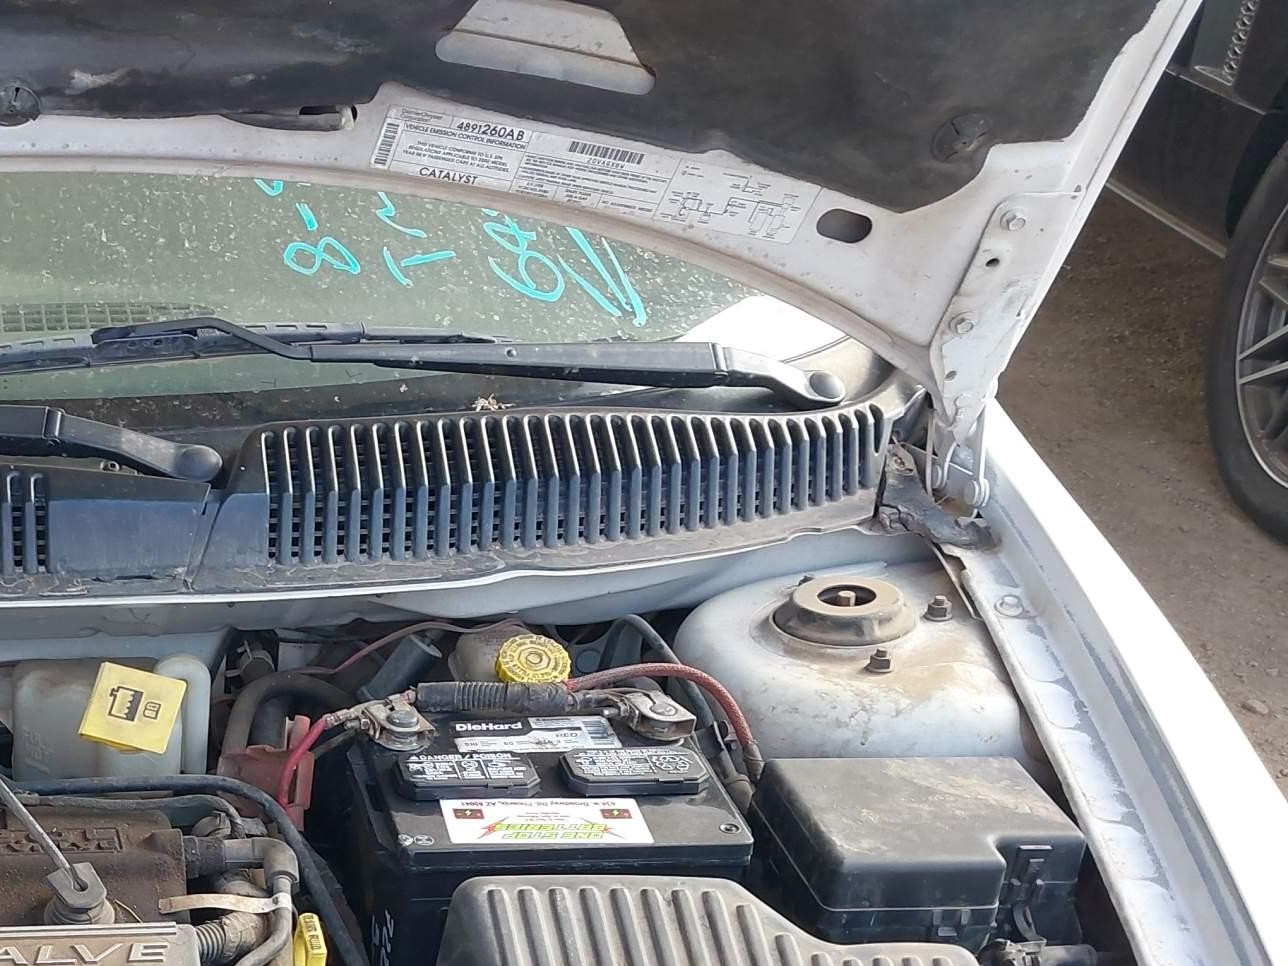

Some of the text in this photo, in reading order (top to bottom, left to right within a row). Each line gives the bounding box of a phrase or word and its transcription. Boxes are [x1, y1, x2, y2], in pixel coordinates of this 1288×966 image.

[405, 122, 526, 150] VEHICLE EMISSION CONTROL INFORMATION
[456, 121, 526, 141] 4891260AB
[418, 166, 479, 186] CATALYST
[455, 722, 522, 732] DieHard
[472, 752, 512, 760] POISON
[495, 824, 607, 832] BATTERIES
[502, 832, 603, 840] ONE STOP
